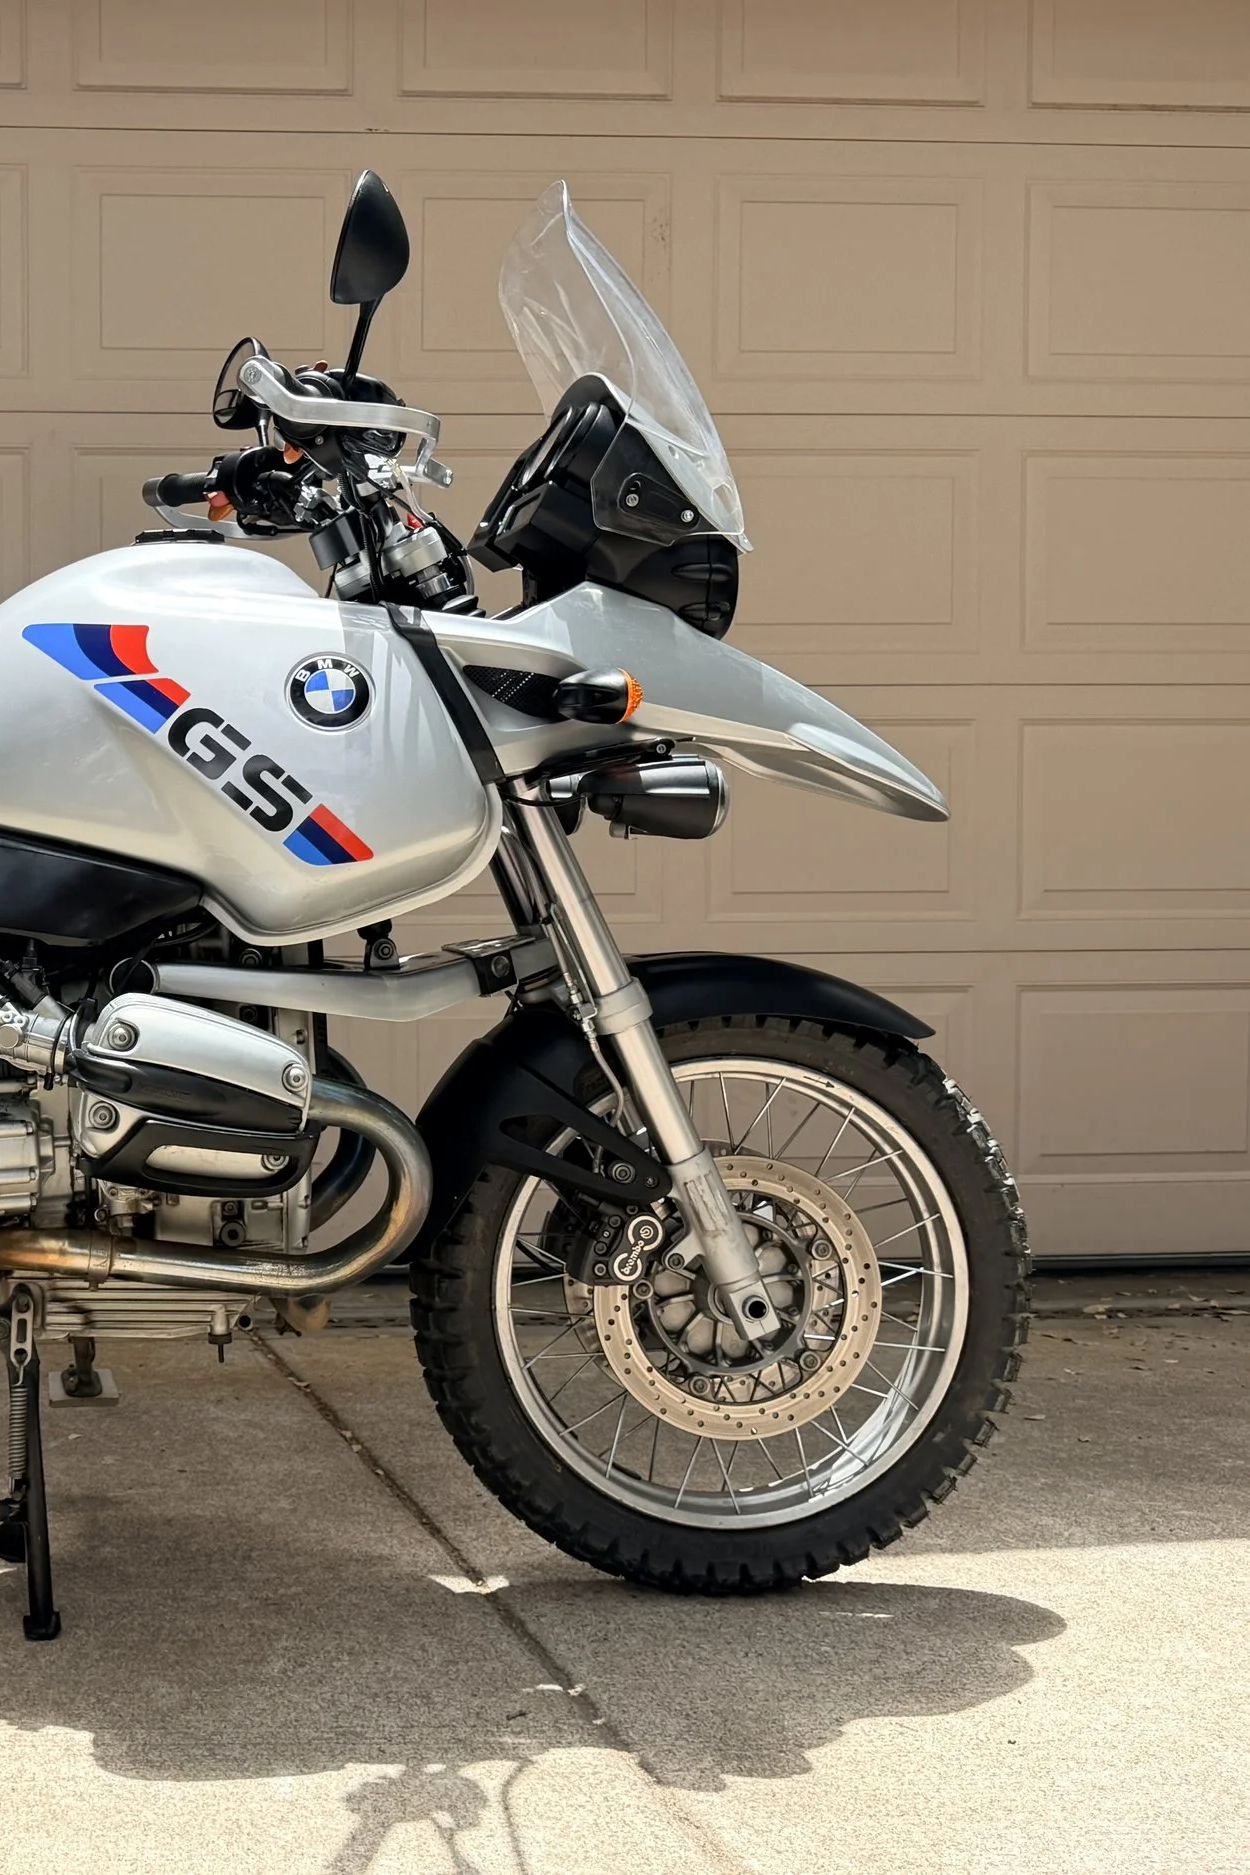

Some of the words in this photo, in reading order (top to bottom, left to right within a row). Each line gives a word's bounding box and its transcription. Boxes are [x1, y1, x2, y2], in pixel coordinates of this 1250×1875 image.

[294, 658, 359, 683] BMW
[167, 707, 312, 833] GS
[620, 1239, 645, 1275] brembo
